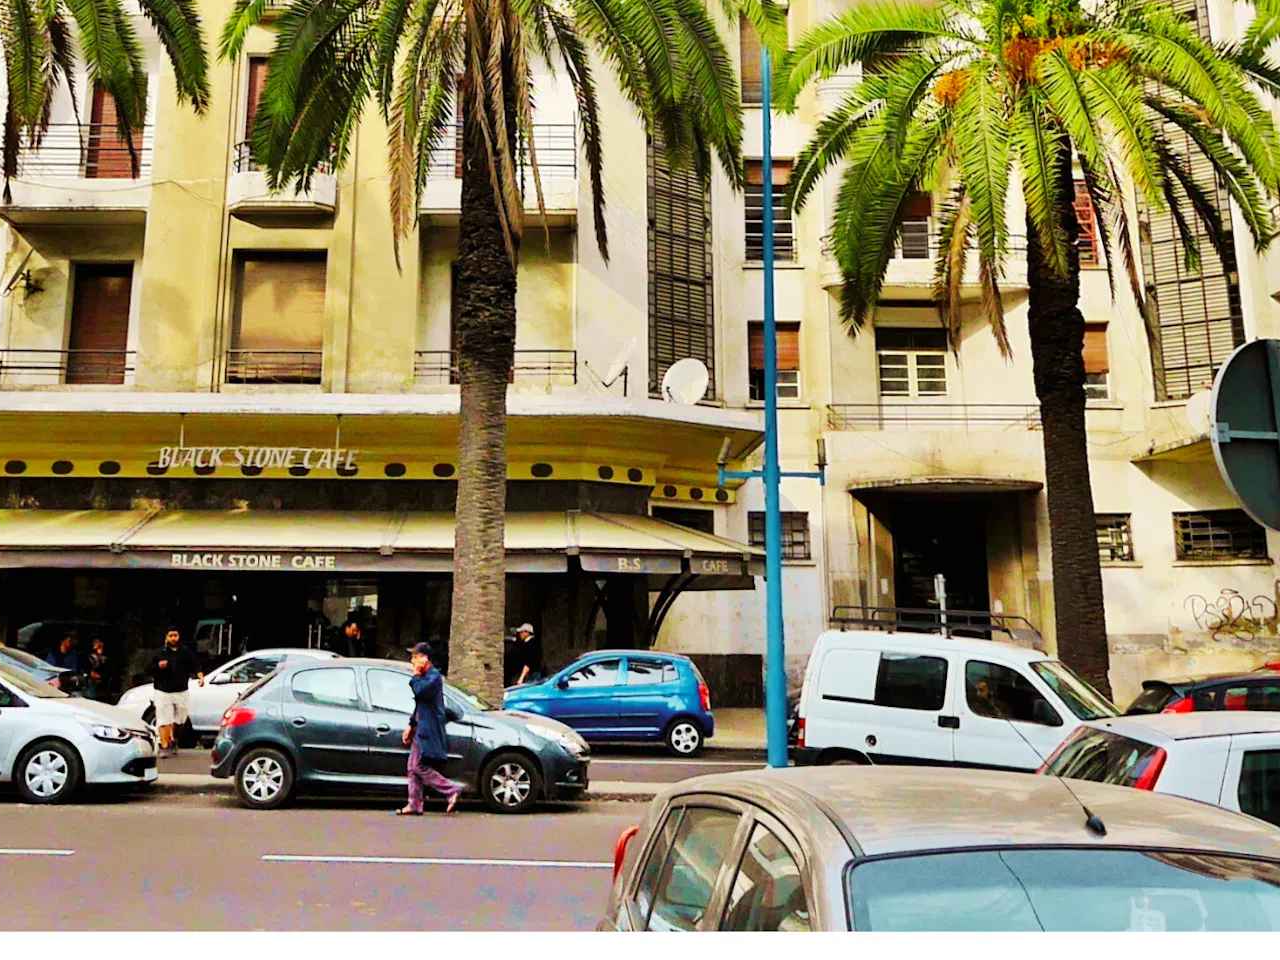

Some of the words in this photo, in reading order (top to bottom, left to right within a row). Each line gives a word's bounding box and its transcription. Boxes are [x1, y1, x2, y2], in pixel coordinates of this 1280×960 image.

[157, 446, 224, 468] BLACK
[231, 446, 296, 468] STONE
[299, 448, 360, 470] CAFE
[171, 553, 224, 568] BLACK
[227, 554, 282, 568] STONE
[290, 555, 337, 569] CAFE
[701, 559, 729, 572] CAFE
